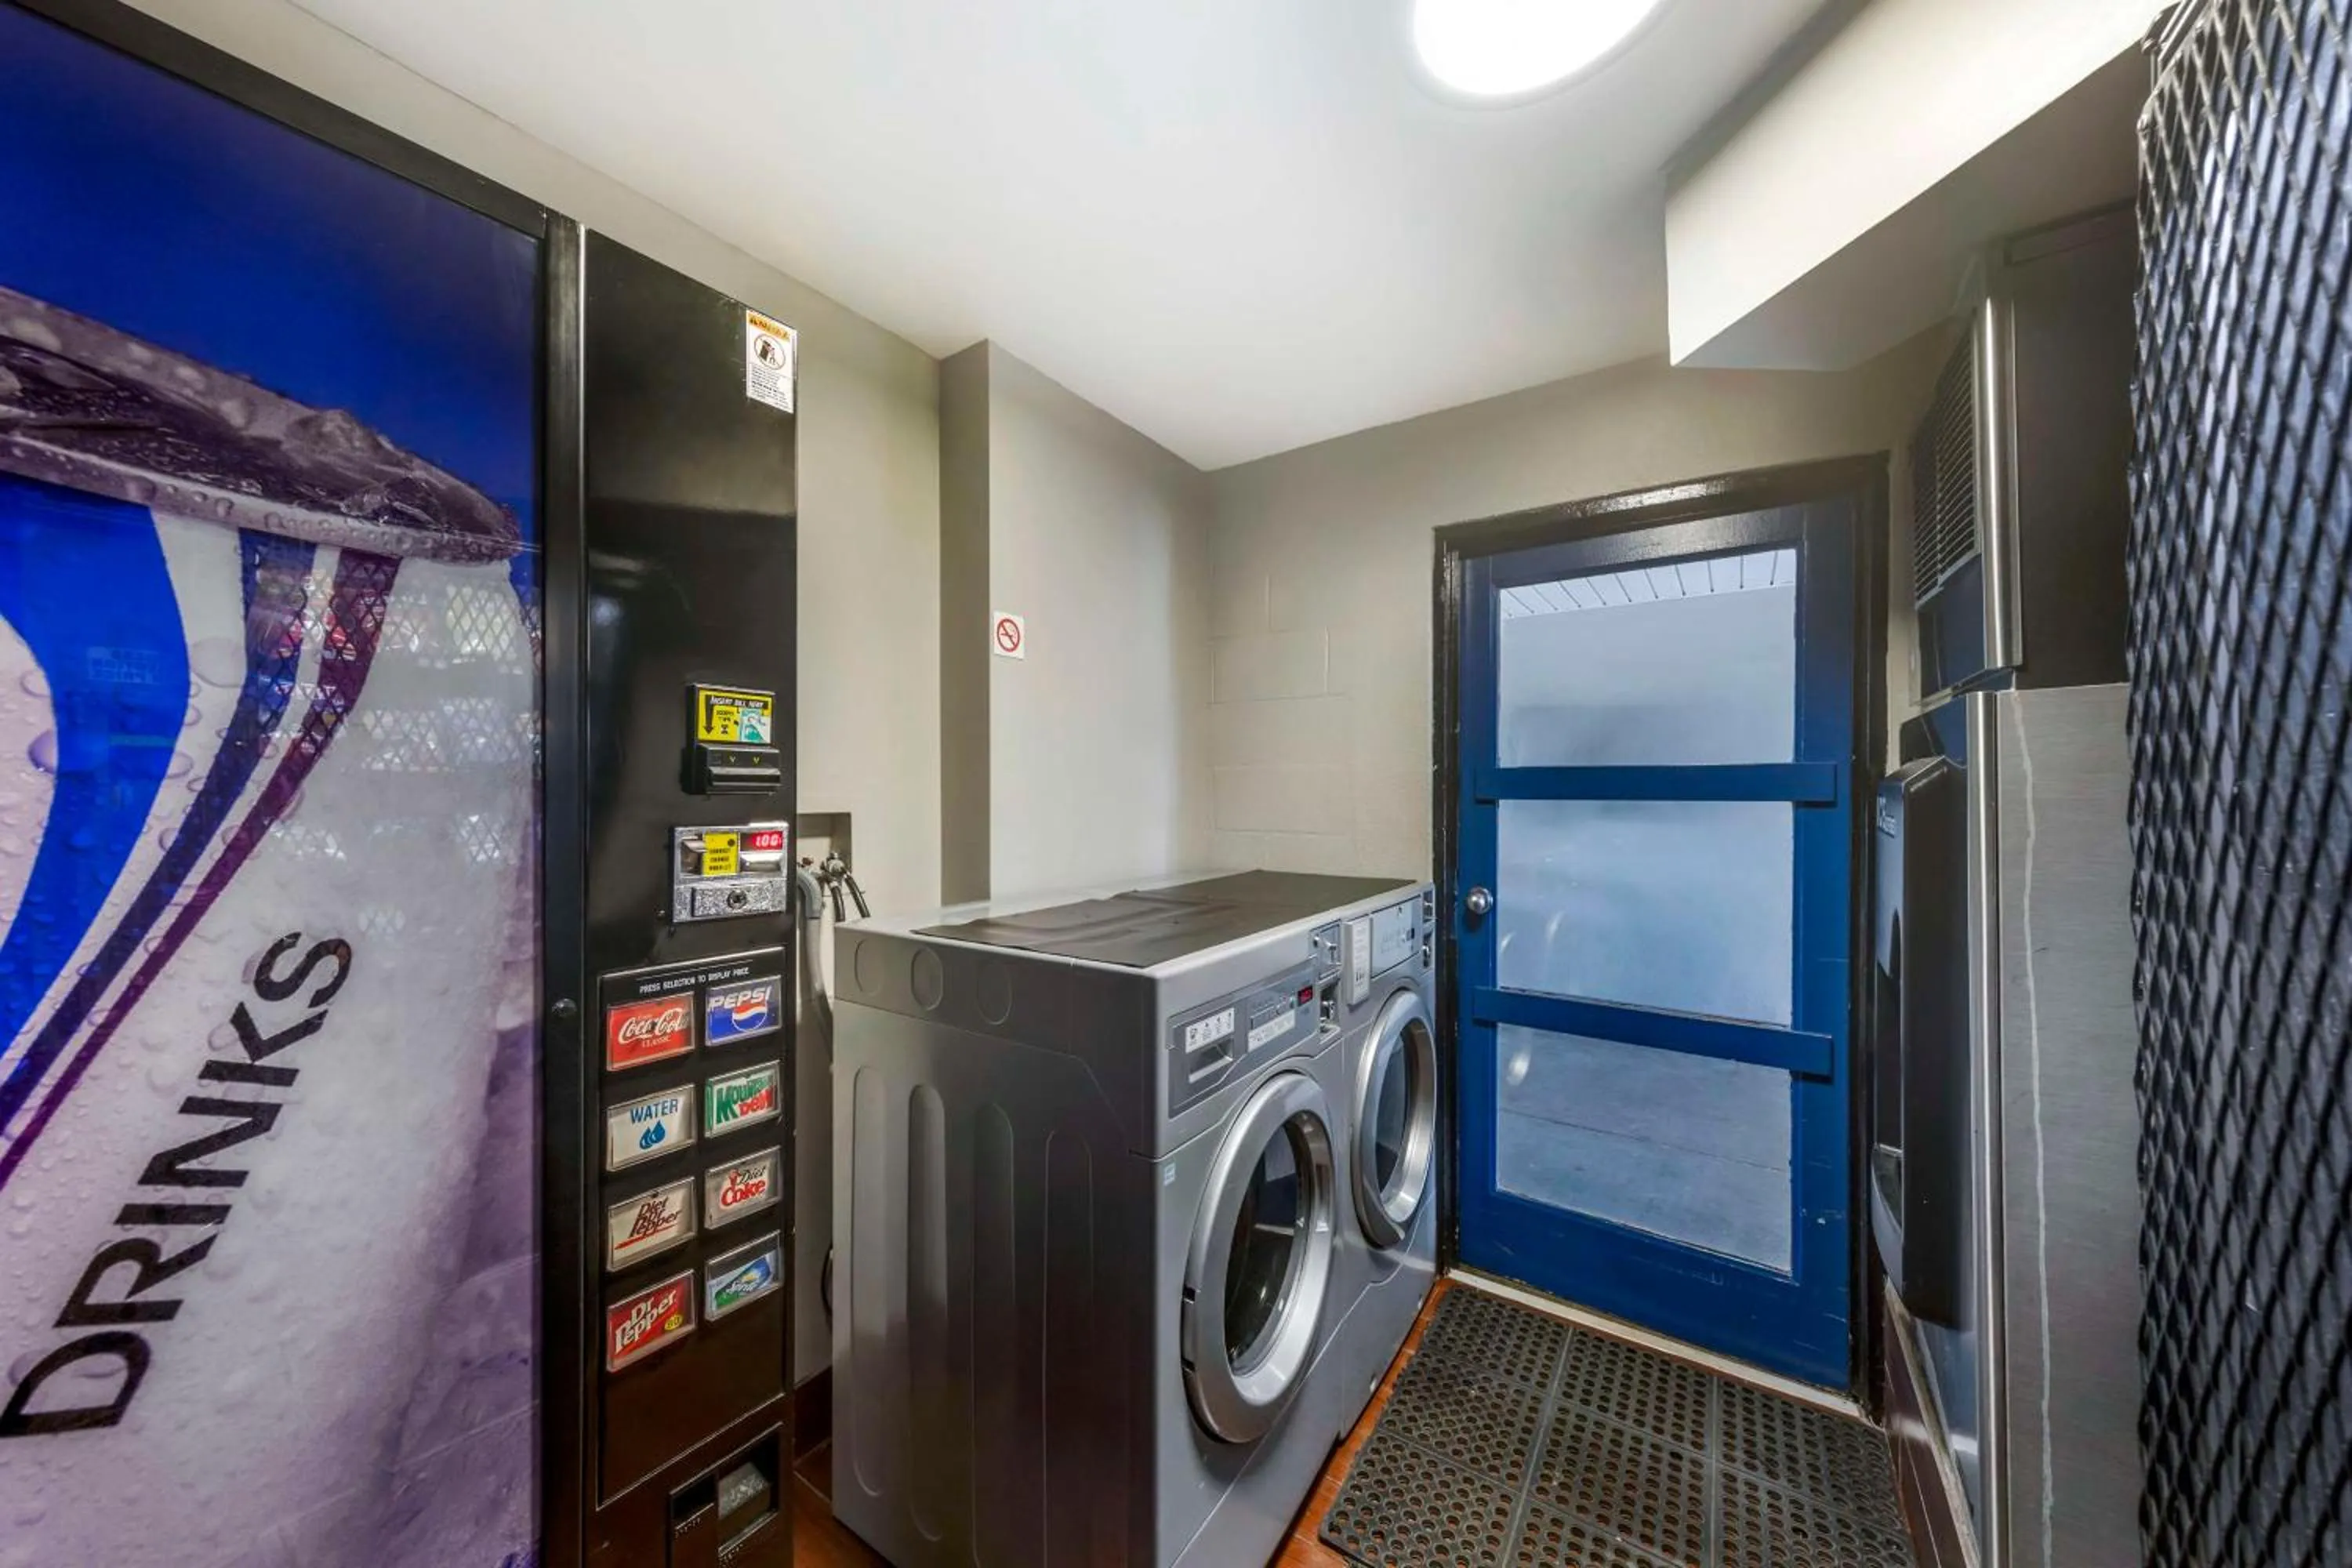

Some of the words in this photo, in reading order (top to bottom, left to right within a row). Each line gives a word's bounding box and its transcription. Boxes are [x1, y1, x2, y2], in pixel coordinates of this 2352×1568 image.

[639, 982, 661, 994] PRESS
[662, 976, 695, 990] SELECTION
[698, 975, 706, 983] TO
[708, 970, 731, 981] DISPLAY
[733, 967, 750, 976] PRICE
[707, 986, 772, 1011] PEPSI
[619, 1007, 690, 1045] Coca-Cola
[630, 1098, 678, 1124] WATER
[0, 931, 353, 1438] DRINKS
[721, 1180, 766, 1206] Coke
[615, 1290, 677, 1355] Pepper
[631, 1297, 655, 1325] Dr
